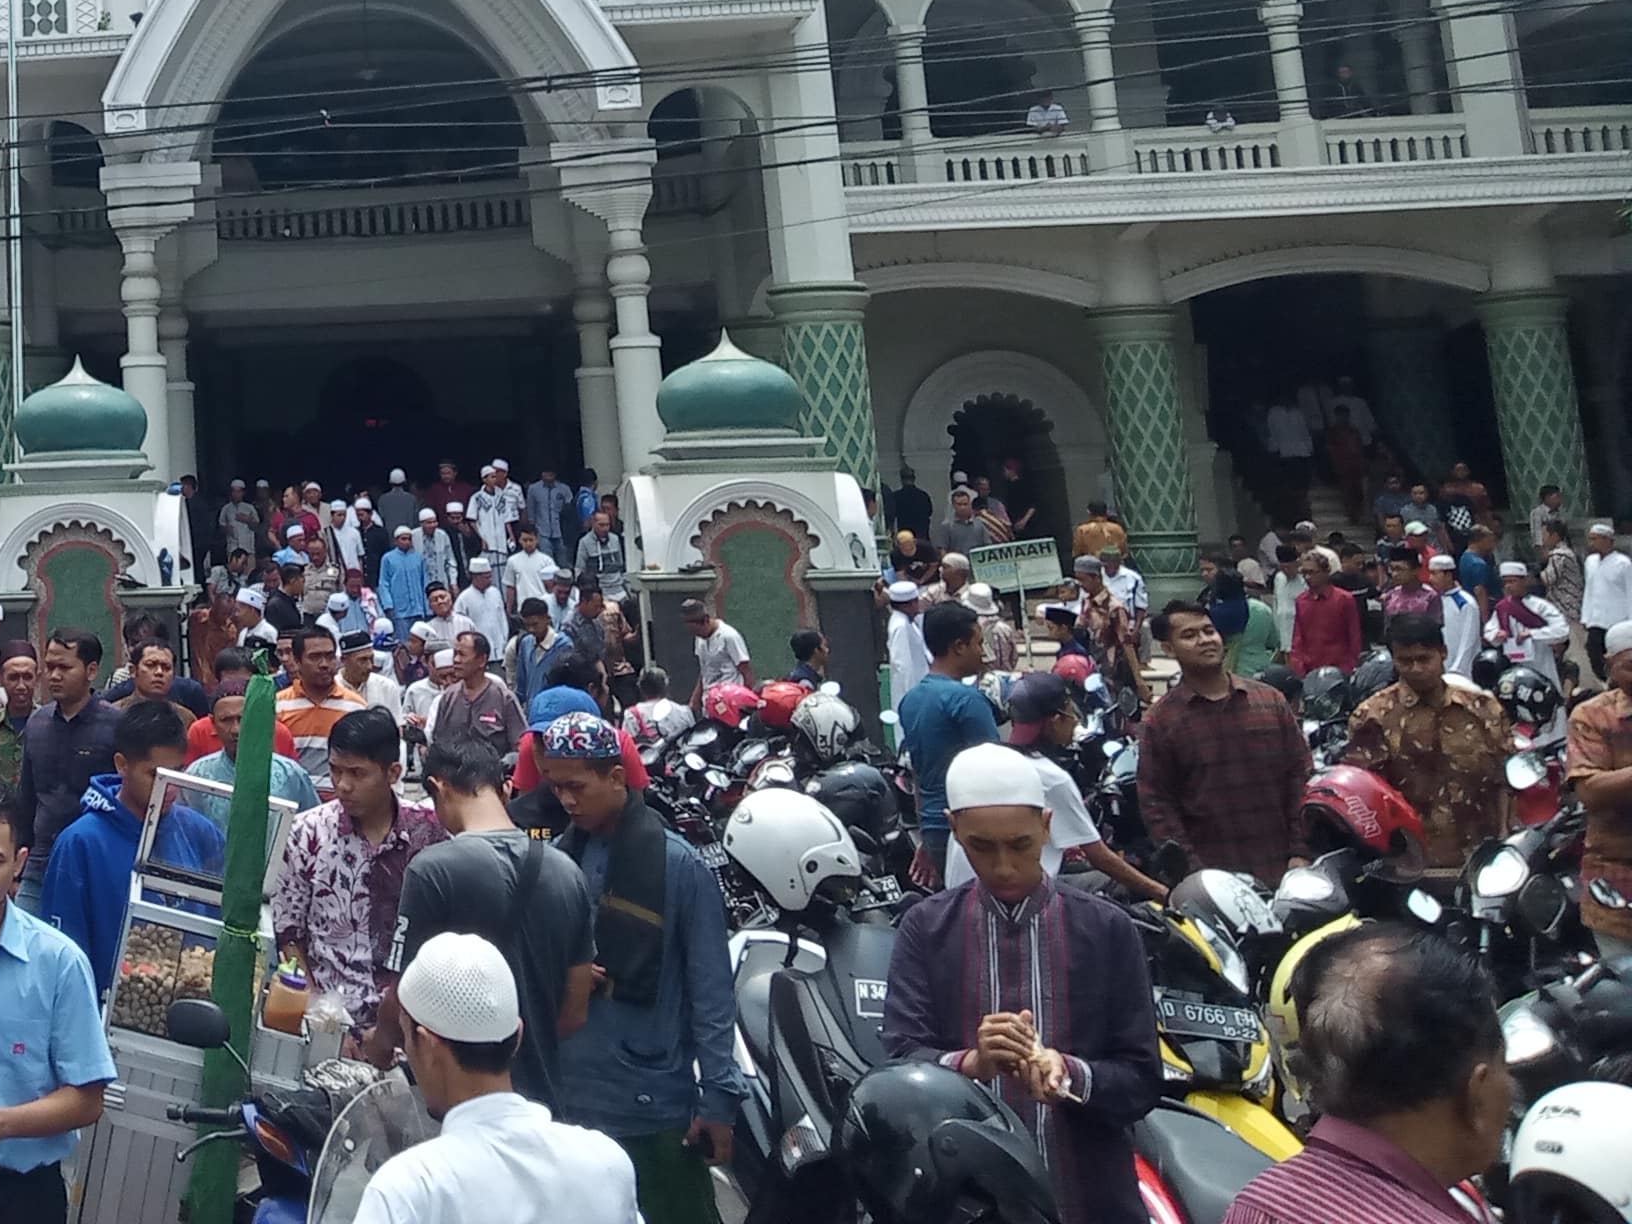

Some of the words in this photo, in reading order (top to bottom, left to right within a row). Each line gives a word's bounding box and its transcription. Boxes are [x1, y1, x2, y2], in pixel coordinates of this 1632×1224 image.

[977, 542, 1052, 564] JAMAAH
[858, 983, 868, 998] N
[1184, 1004, 1227, 1025] 6766
